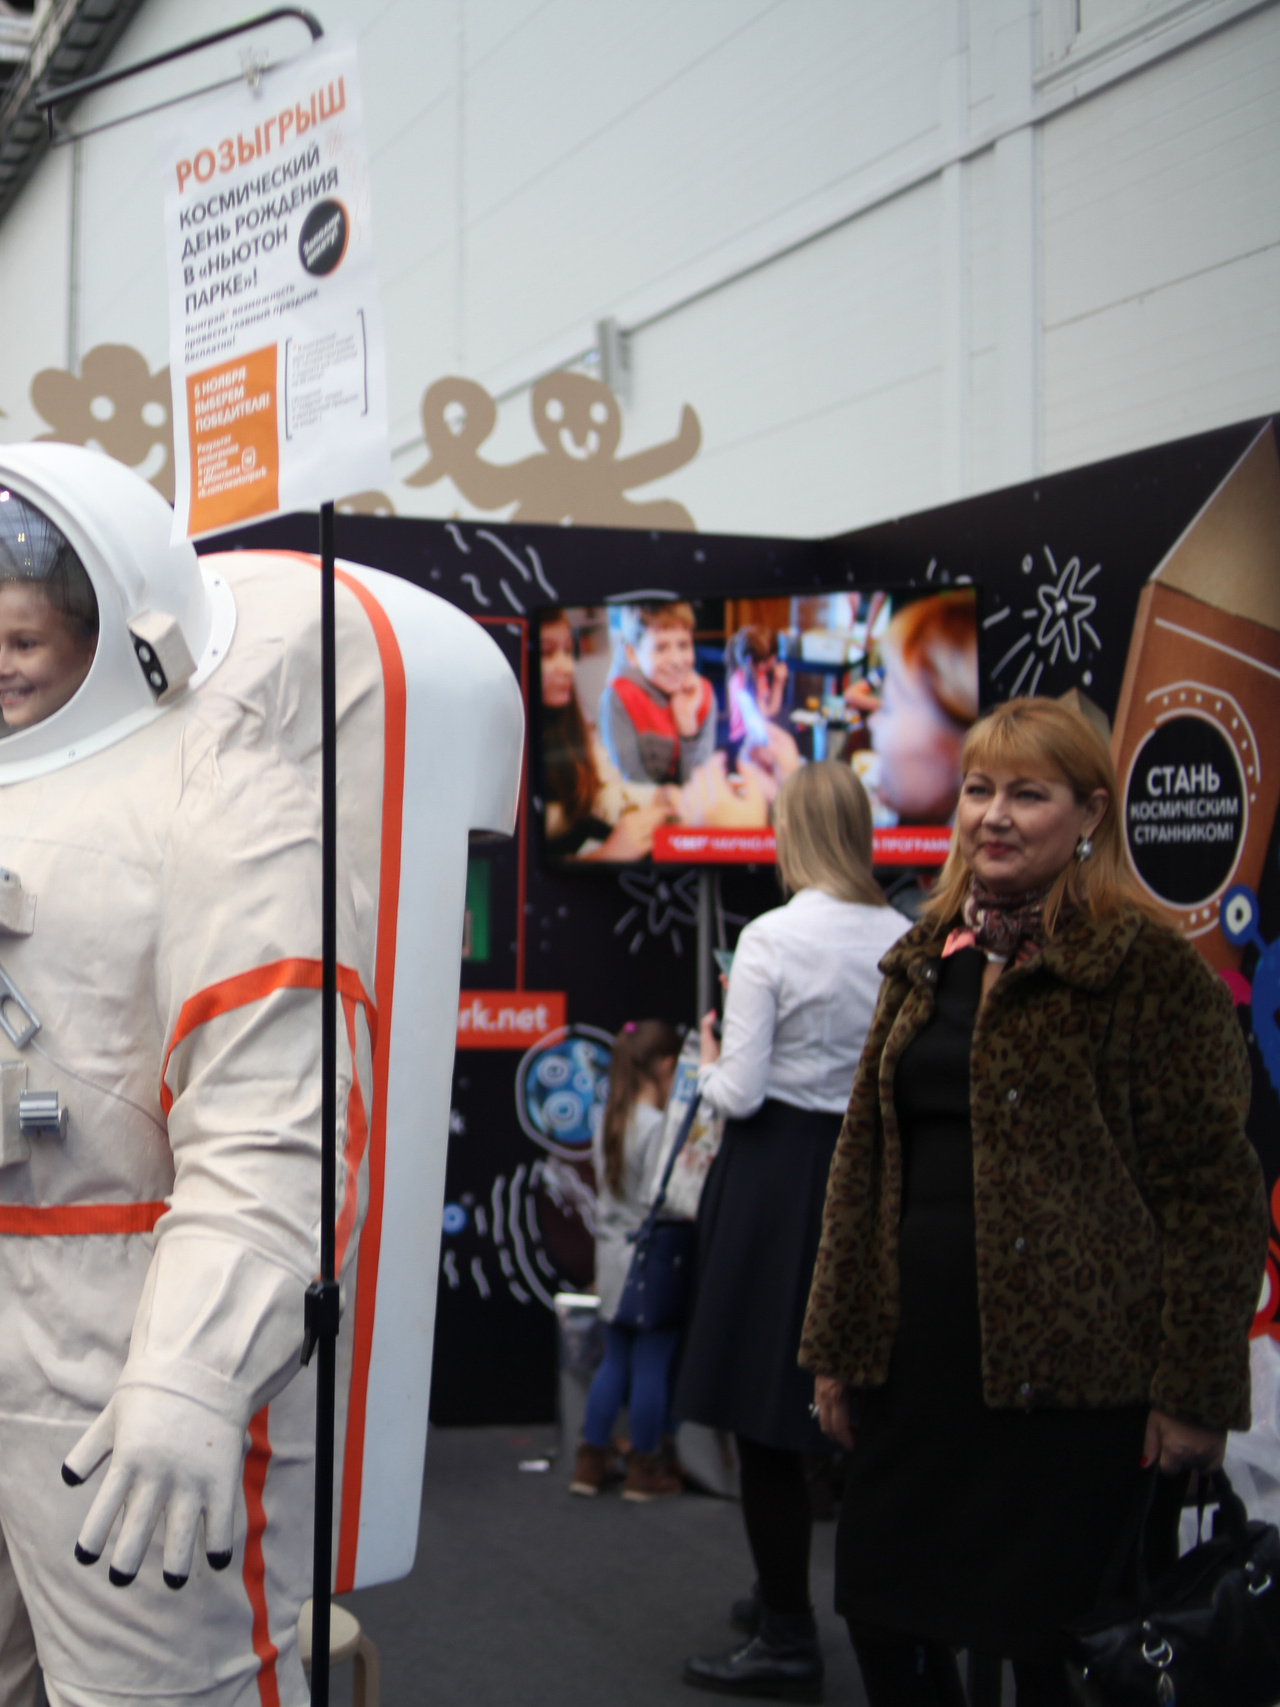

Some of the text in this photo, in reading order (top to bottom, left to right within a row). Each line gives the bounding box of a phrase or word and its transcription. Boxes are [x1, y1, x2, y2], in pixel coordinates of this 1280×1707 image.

[176, 74, 347, 195] РОЗЫГРЫШ
[180, 141, 320, 231] КОСМИЧЕСКИЙ
[182, 166, 338, 262] ДЕНЬ РОЖДЕНИЯ
[184, 266, 195, 287] В
[199, 223, 288, 279] «НЬЮТОН
[185, 266, 258, 315] ПАРКЕ»!
[195, 384, 245, 417] ВЫБЕРЕМ
[202, 366, 246, 397] НОЯБРЯ
[196, 391, 270, 434] ПОБЕДИТЕЛЯ!
[1146, 763, 1221, 797] СТАНЬ
[1130, 797, 1239, 820] КОСМИЧЕСКИМ
[1134, 822, 1234, 845] СТРАННИКОМ!
[457, 998, 548, 1032] rk.net
